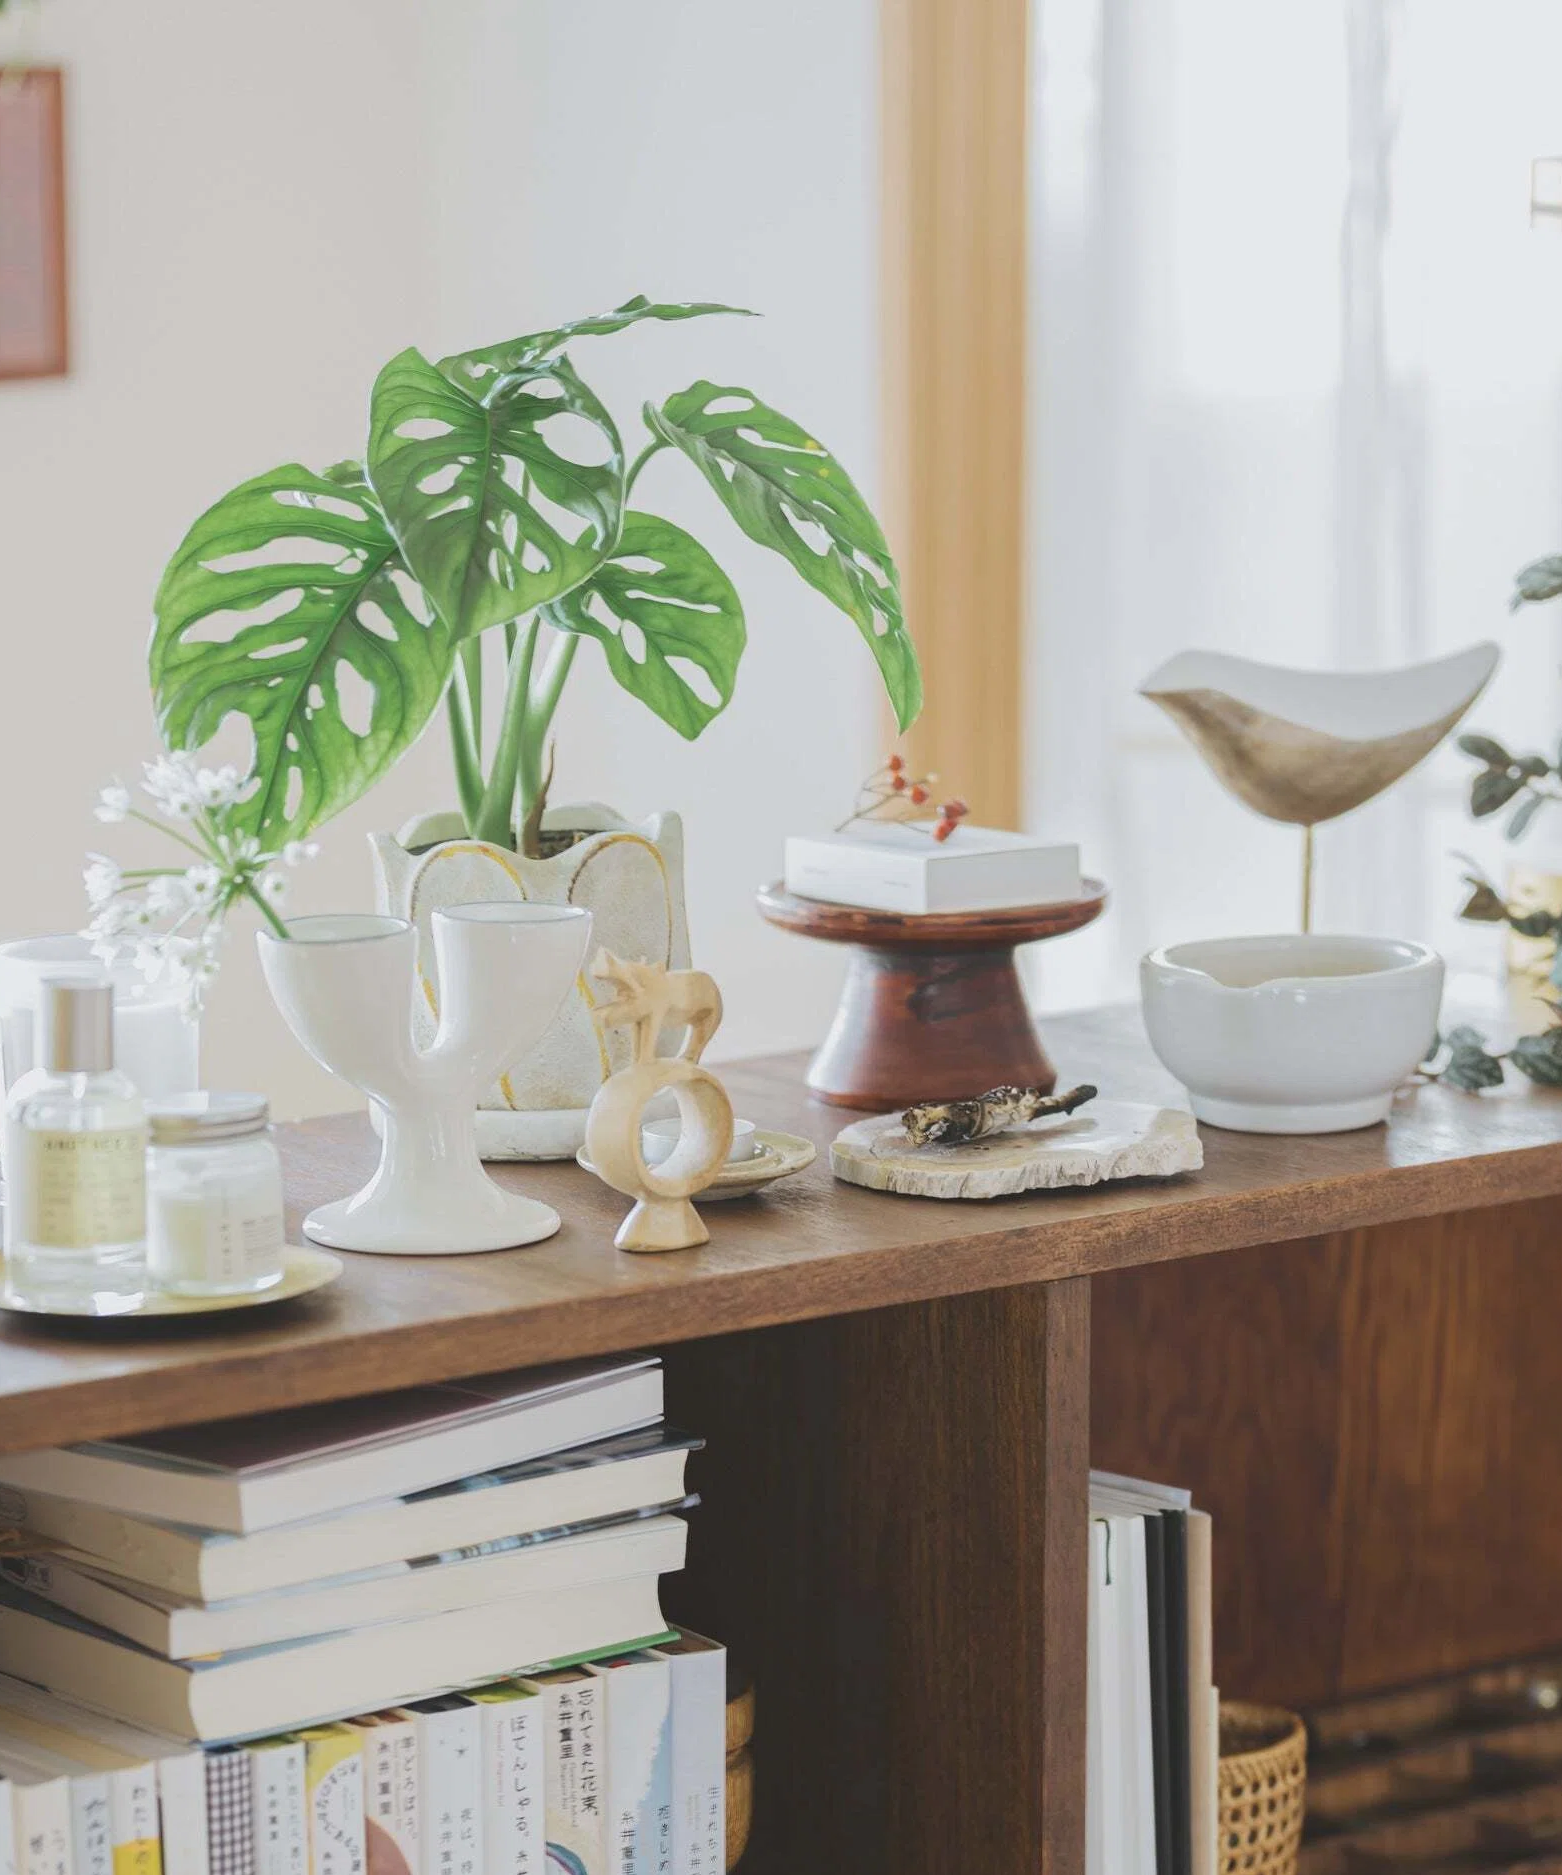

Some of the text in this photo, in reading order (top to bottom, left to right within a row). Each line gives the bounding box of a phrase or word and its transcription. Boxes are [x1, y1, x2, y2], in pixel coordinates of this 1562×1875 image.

[558, 1694, 574, 1760] 糸井重里
[377, 1741, 391, 1816] 糸井重里
